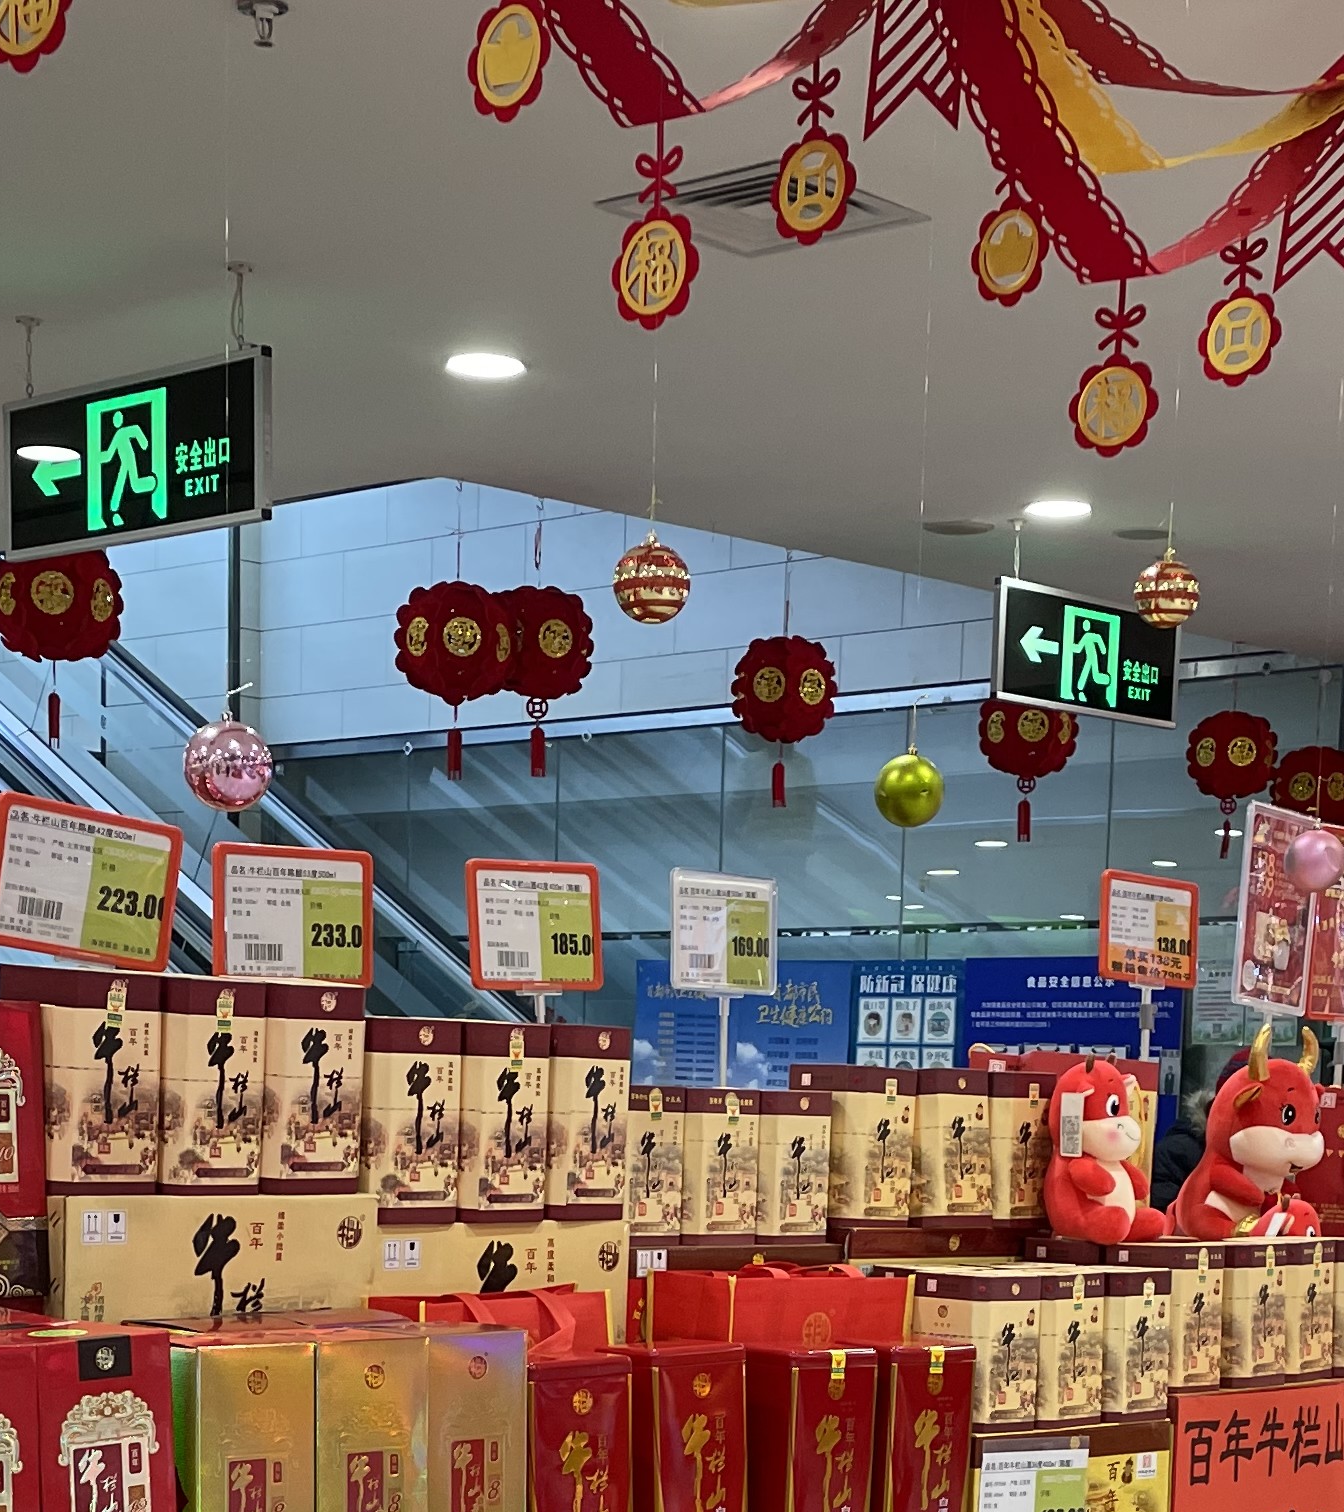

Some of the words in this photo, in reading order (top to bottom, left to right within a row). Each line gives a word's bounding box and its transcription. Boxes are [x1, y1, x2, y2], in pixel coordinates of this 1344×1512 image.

[175, 437, 229, 474] 安全出口
[185, 474, 220, 497] EXIT
[1122, 659, 1159, 684] 安全出口
[1128, 686, 1152, 701] EXIT
[311, 922, 363, 949] 233.0
[859, 974, 906, 994] 防新冠
[911, 974, 958, 994] 保健康
[1026, 975, 1116, 989] 食品安全信息公示
[487, 1479, 501, 1500] 8
